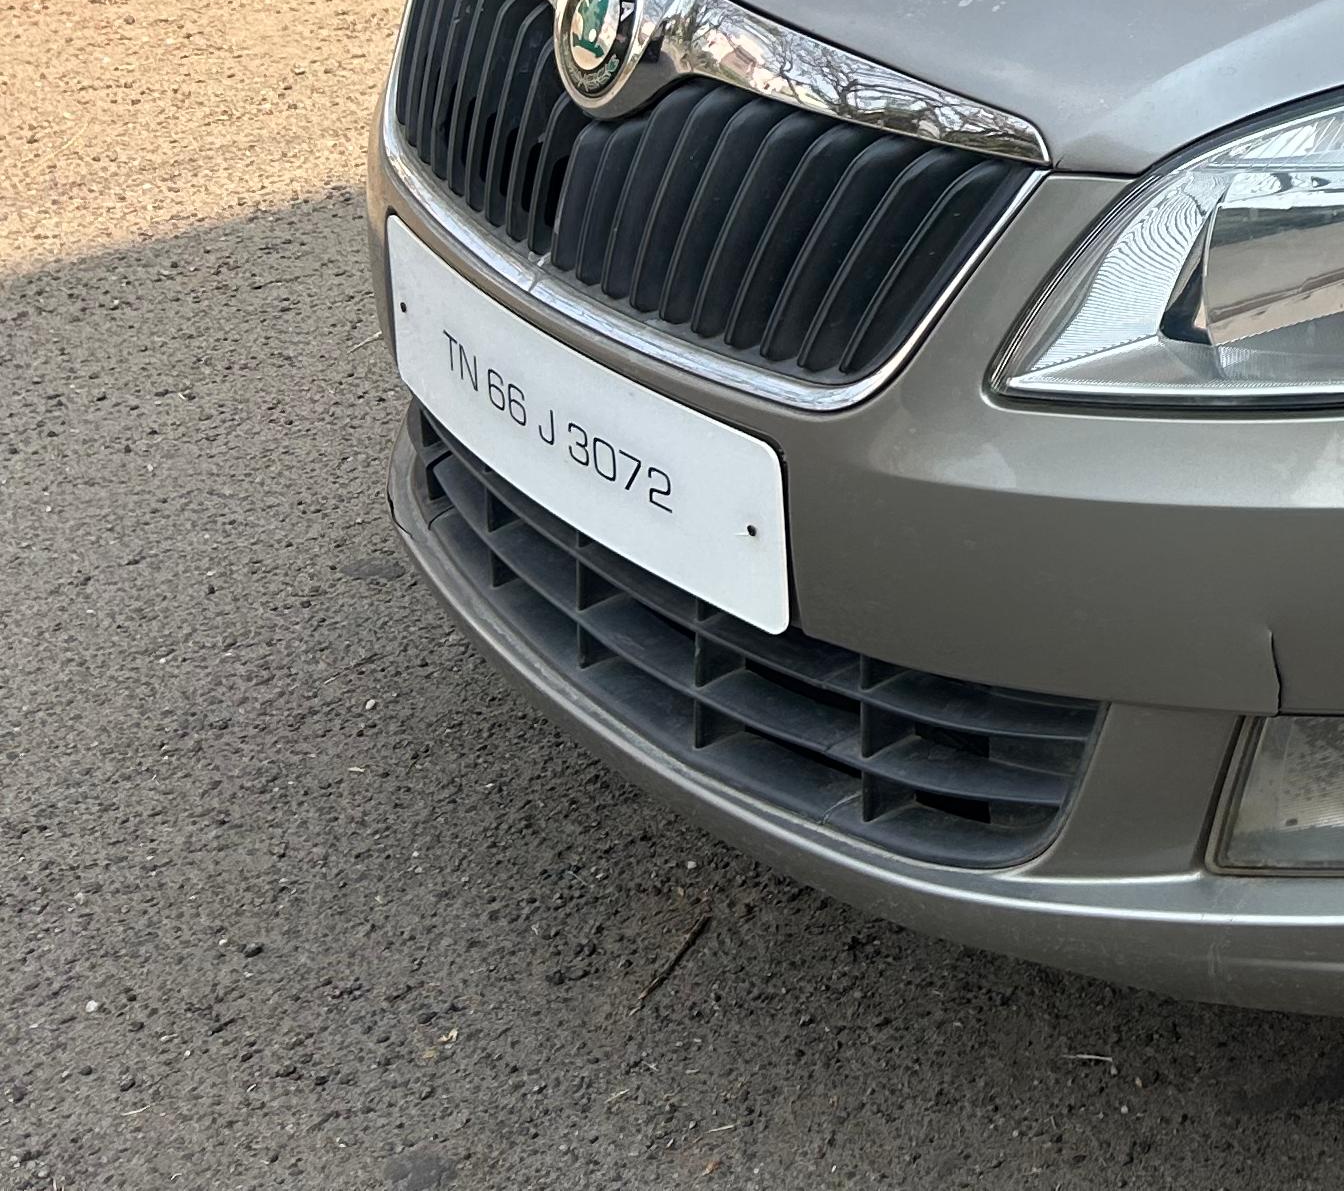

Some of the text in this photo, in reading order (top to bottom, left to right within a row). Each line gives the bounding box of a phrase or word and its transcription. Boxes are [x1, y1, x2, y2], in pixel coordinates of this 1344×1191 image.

[443, 329, 673, 514] TN 66 J 3072
